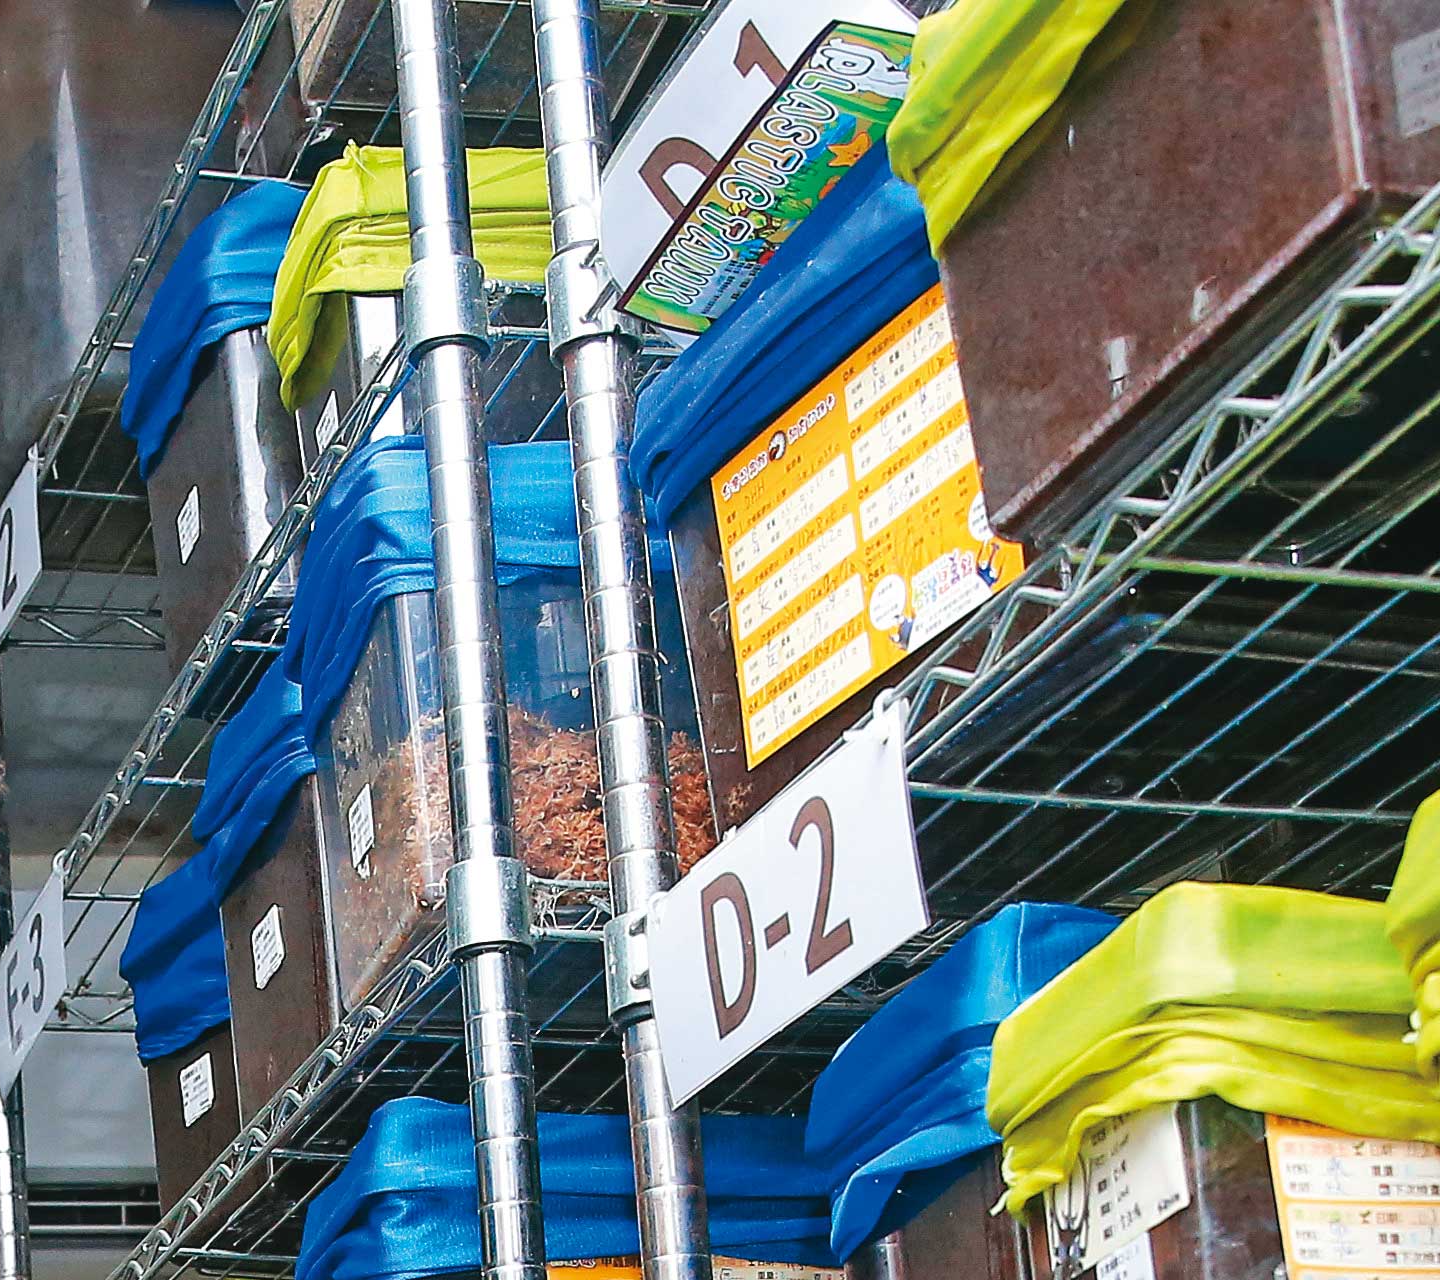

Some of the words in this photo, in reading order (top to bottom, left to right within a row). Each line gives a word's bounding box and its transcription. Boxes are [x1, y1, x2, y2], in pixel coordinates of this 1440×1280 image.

[717, 45, 876, 211] PLASTIC
[643, 204, 755, 307] TANK
[6, 912, 45, 1055] E-3
[700, 795, 853, 1039] D-2
